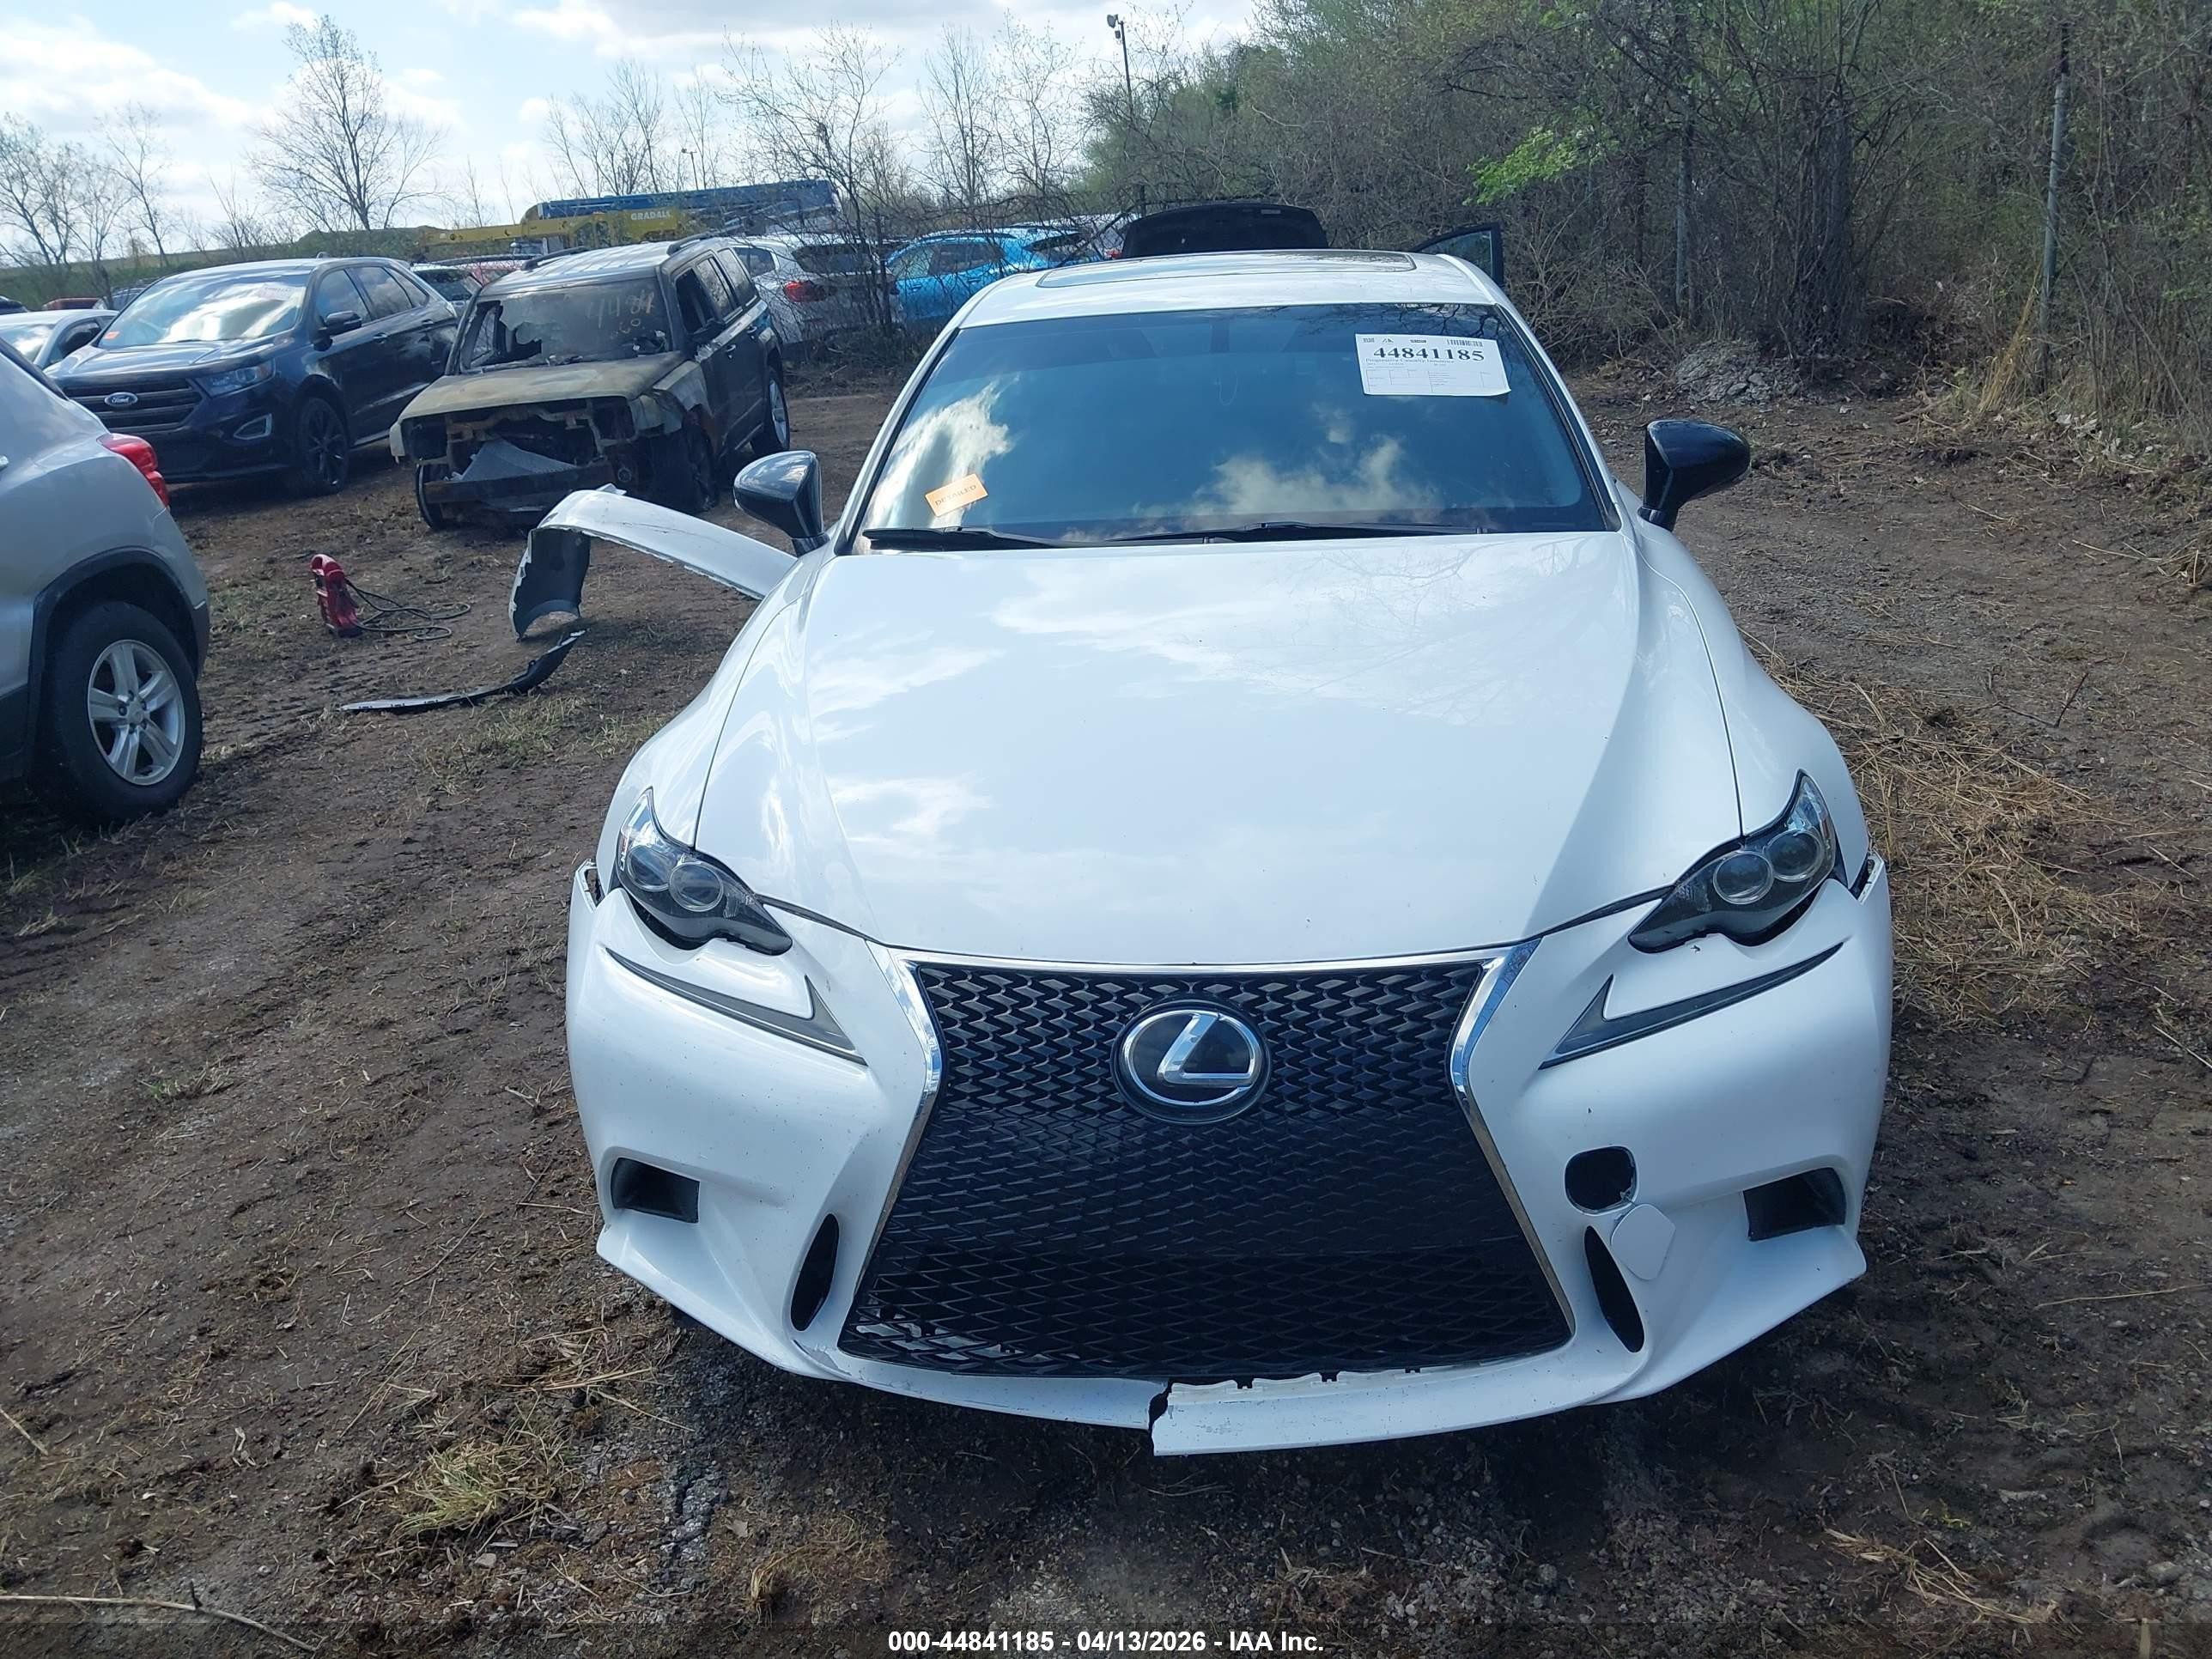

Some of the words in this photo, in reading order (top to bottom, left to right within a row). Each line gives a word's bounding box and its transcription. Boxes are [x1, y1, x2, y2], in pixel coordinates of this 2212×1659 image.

[630, 210, 673, 221] GRADALL
[1373, 347, 1485, 362] 44841185
[934, 484, 977, 506] DETAILED
